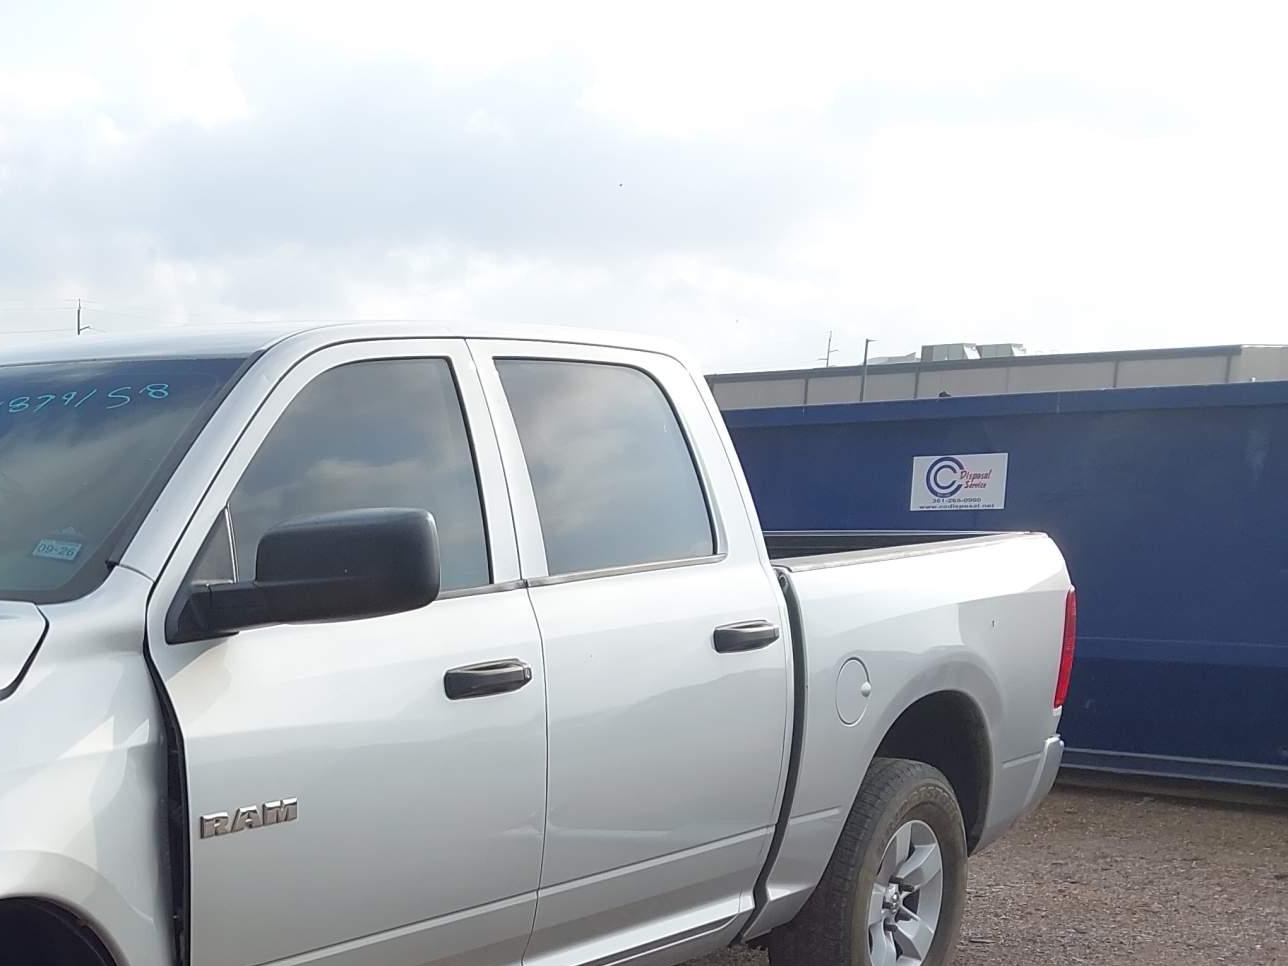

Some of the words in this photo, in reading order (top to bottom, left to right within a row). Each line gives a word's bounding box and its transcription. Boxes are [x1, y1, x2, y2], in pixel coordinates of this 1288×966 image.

[960, 469, 992, 481] Disposal
[964, 480, 987, 489] Service
[199, 797, 298, 839] RAM
